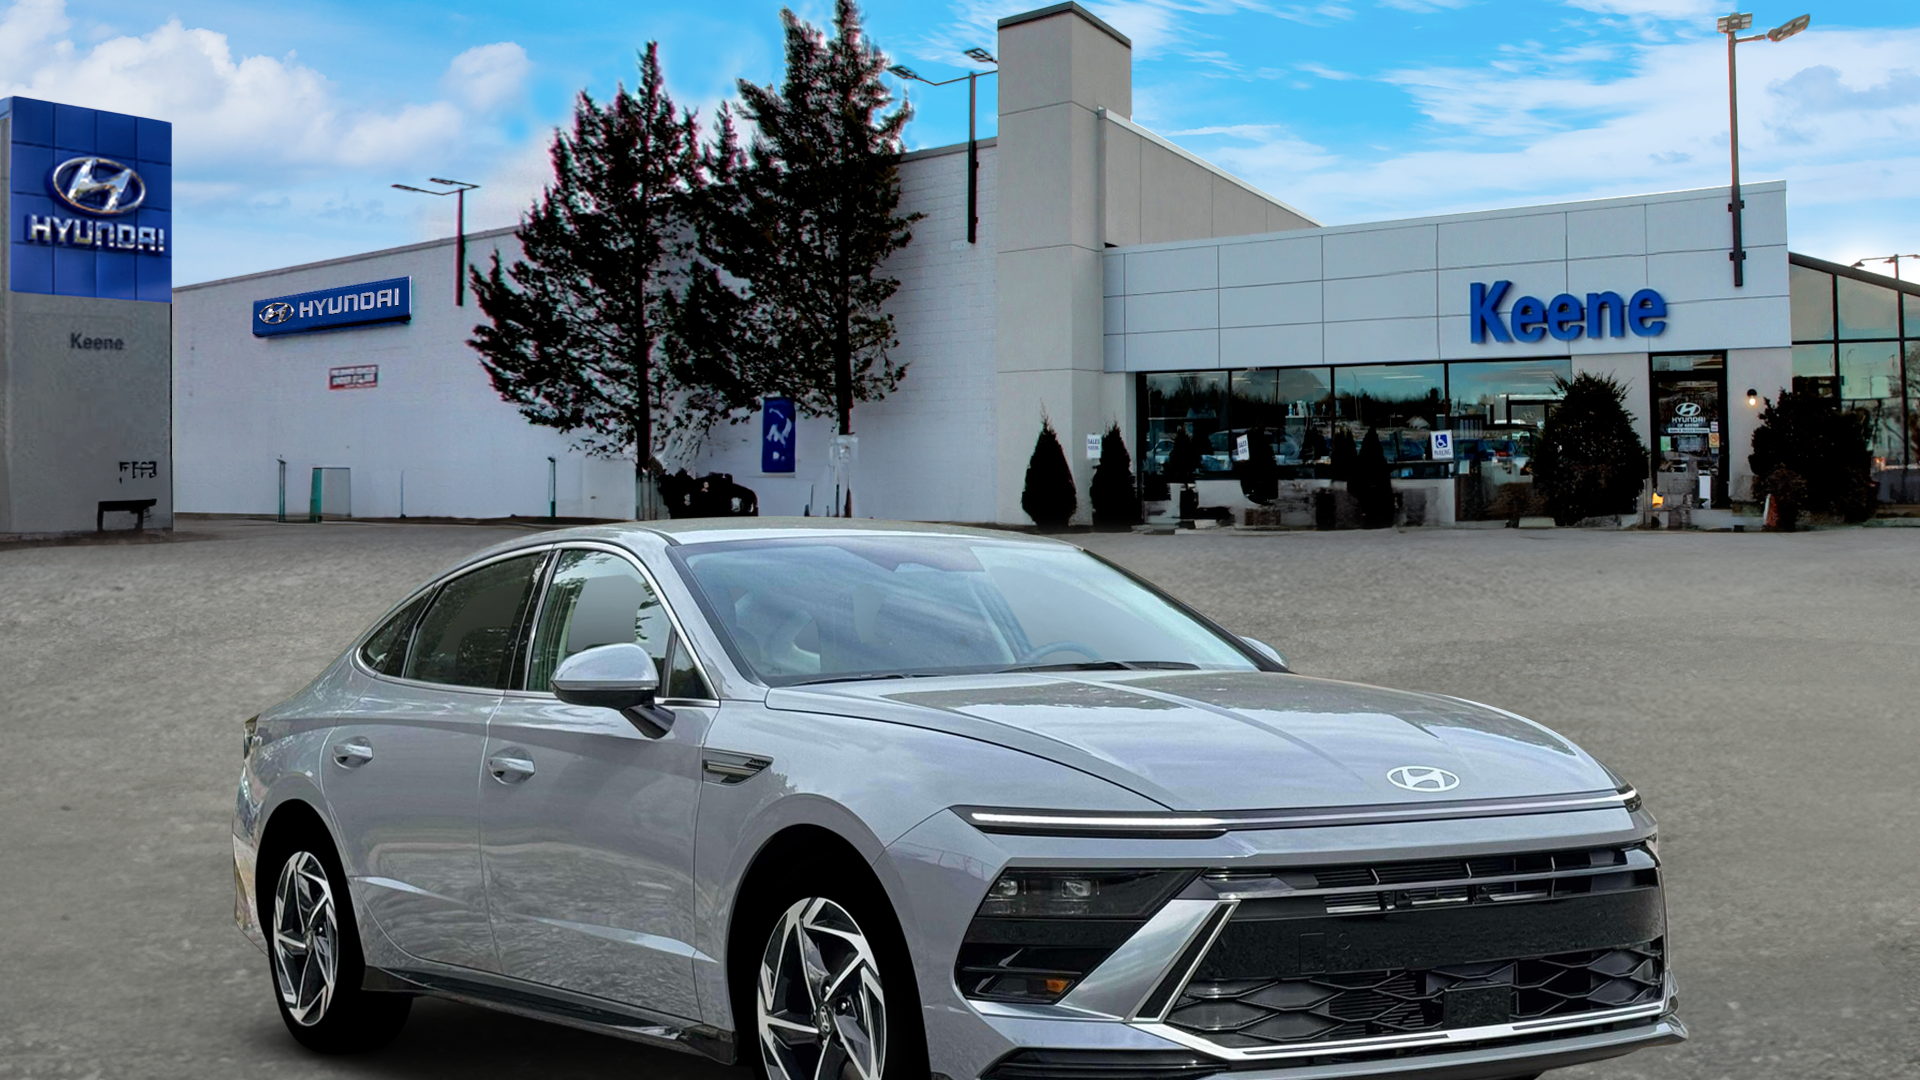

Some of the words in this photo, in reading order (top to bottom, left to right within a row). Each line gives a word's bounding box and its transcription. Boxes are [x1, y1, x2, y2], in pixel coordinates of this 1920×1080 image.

[30, 214, 165, 252] HYUNDAI
[299, 287, 399, 318] HYUNDAI
[1470, 280, 1668, 344] Keene
[69, 332, 125, 351] Keene
